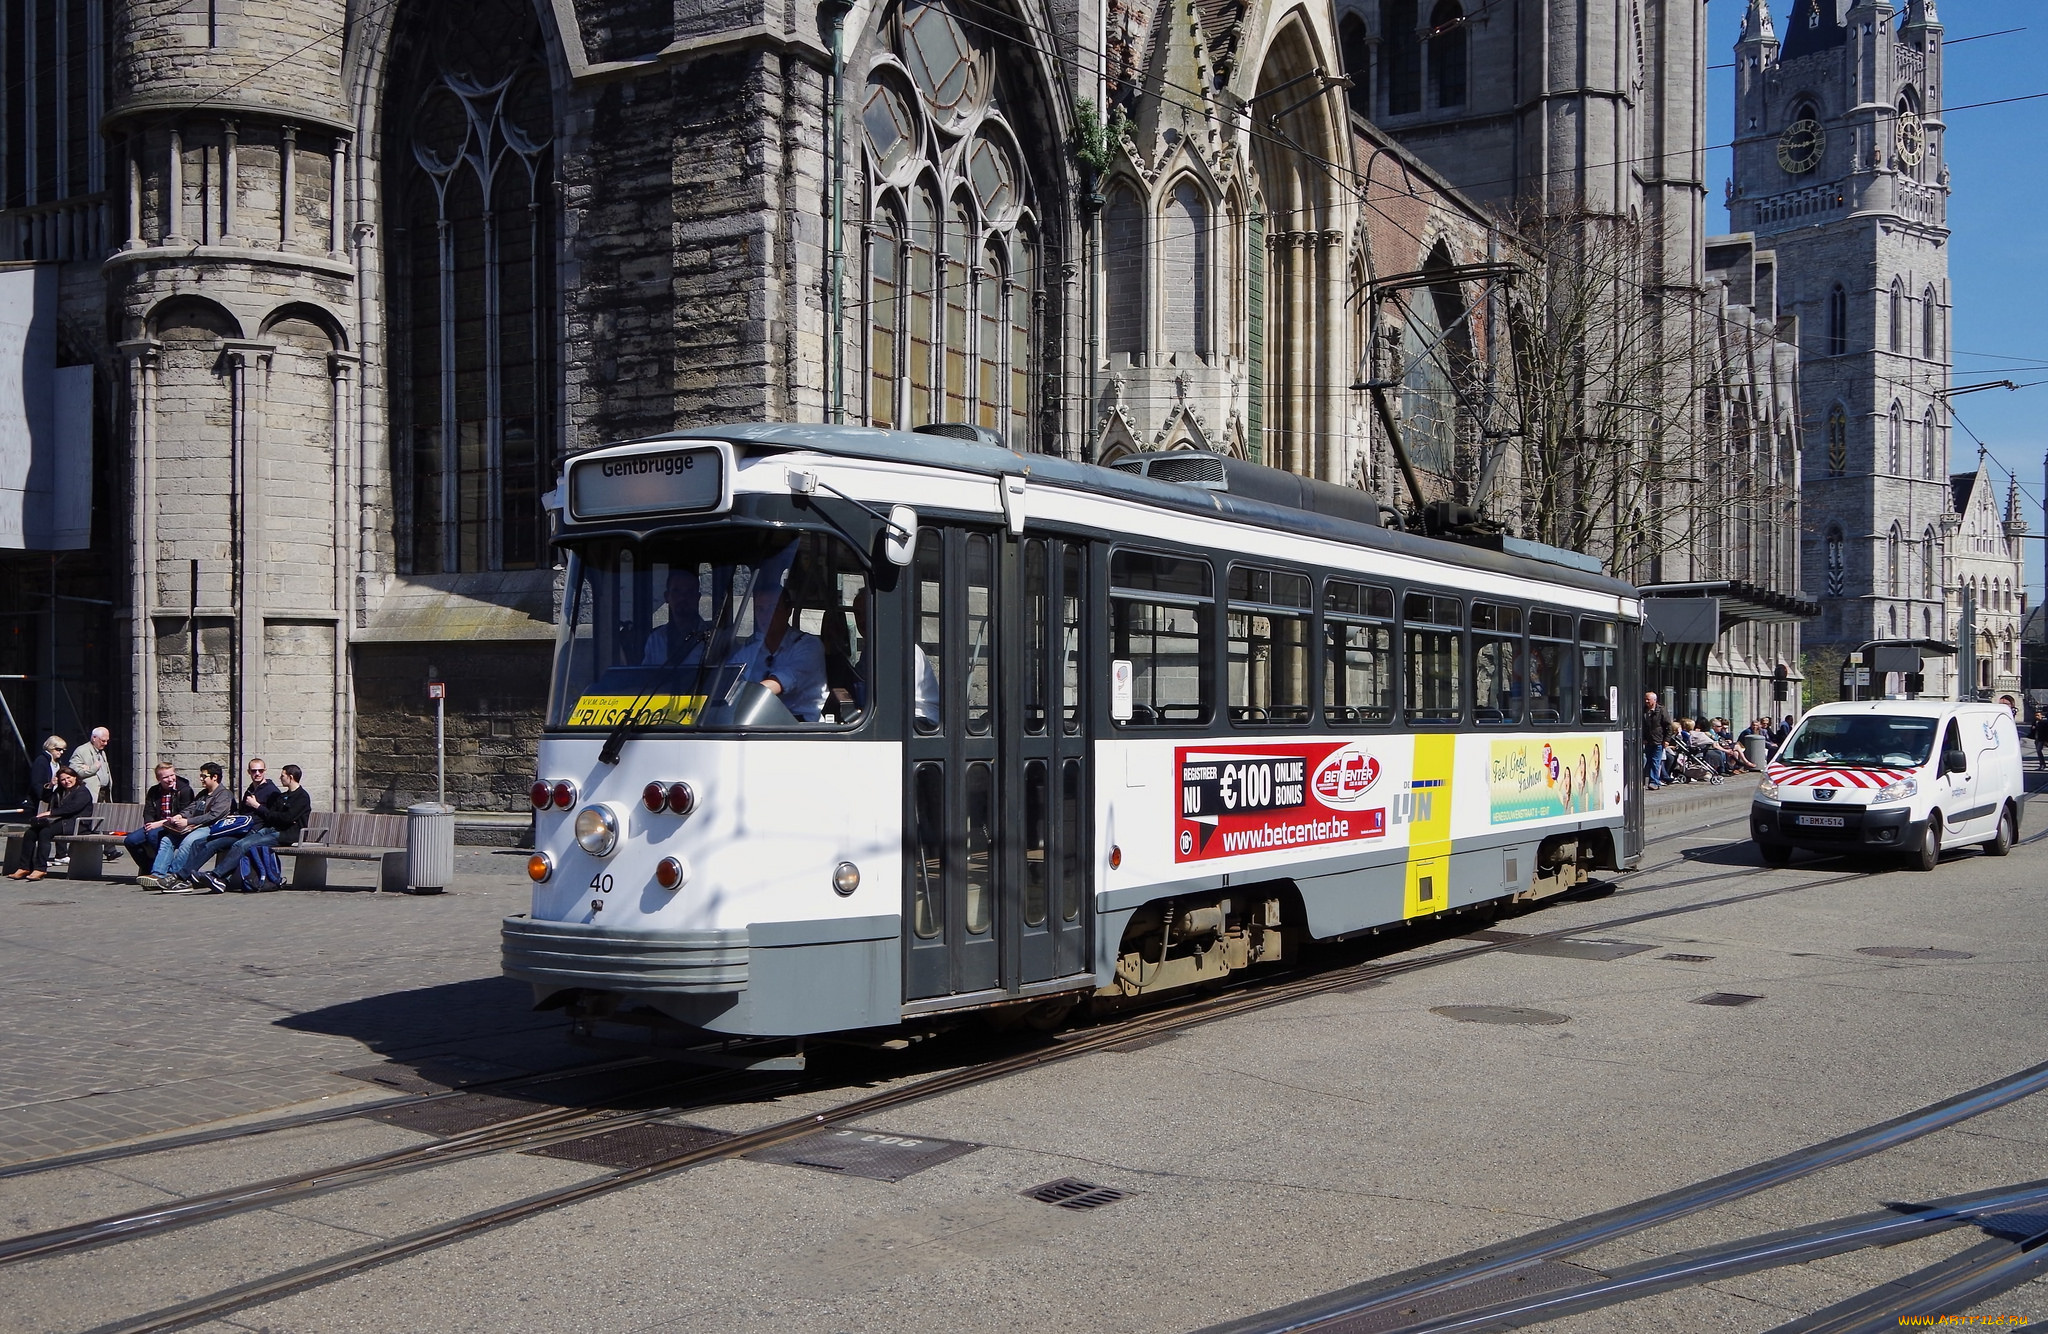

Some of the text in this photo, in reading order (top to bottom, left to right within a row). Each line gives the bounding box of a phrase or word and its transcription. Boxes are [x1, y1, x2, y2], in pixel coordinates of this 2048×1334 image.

[602, 455, 694, 477] Gentbrugge
[1183, 766, 1218, 781] REGISTREER
[1274, 762, 1303, 783] ONLINE
[1493, 755, 1508, 783] Feel
[1510, 745, 1527, 779] Good
[1220, 763, 1271, 810] €100
[1403, 781, 1410, 789] DE
[1518, 767, 1542, 793] Fashion
[1183, 785, 1201, 814] NU
[1275, 784, 1303, 806] BONUS
[1222, 815, 1349, 852] www.betcenter.be
[589, 872, 614, 894] 40
